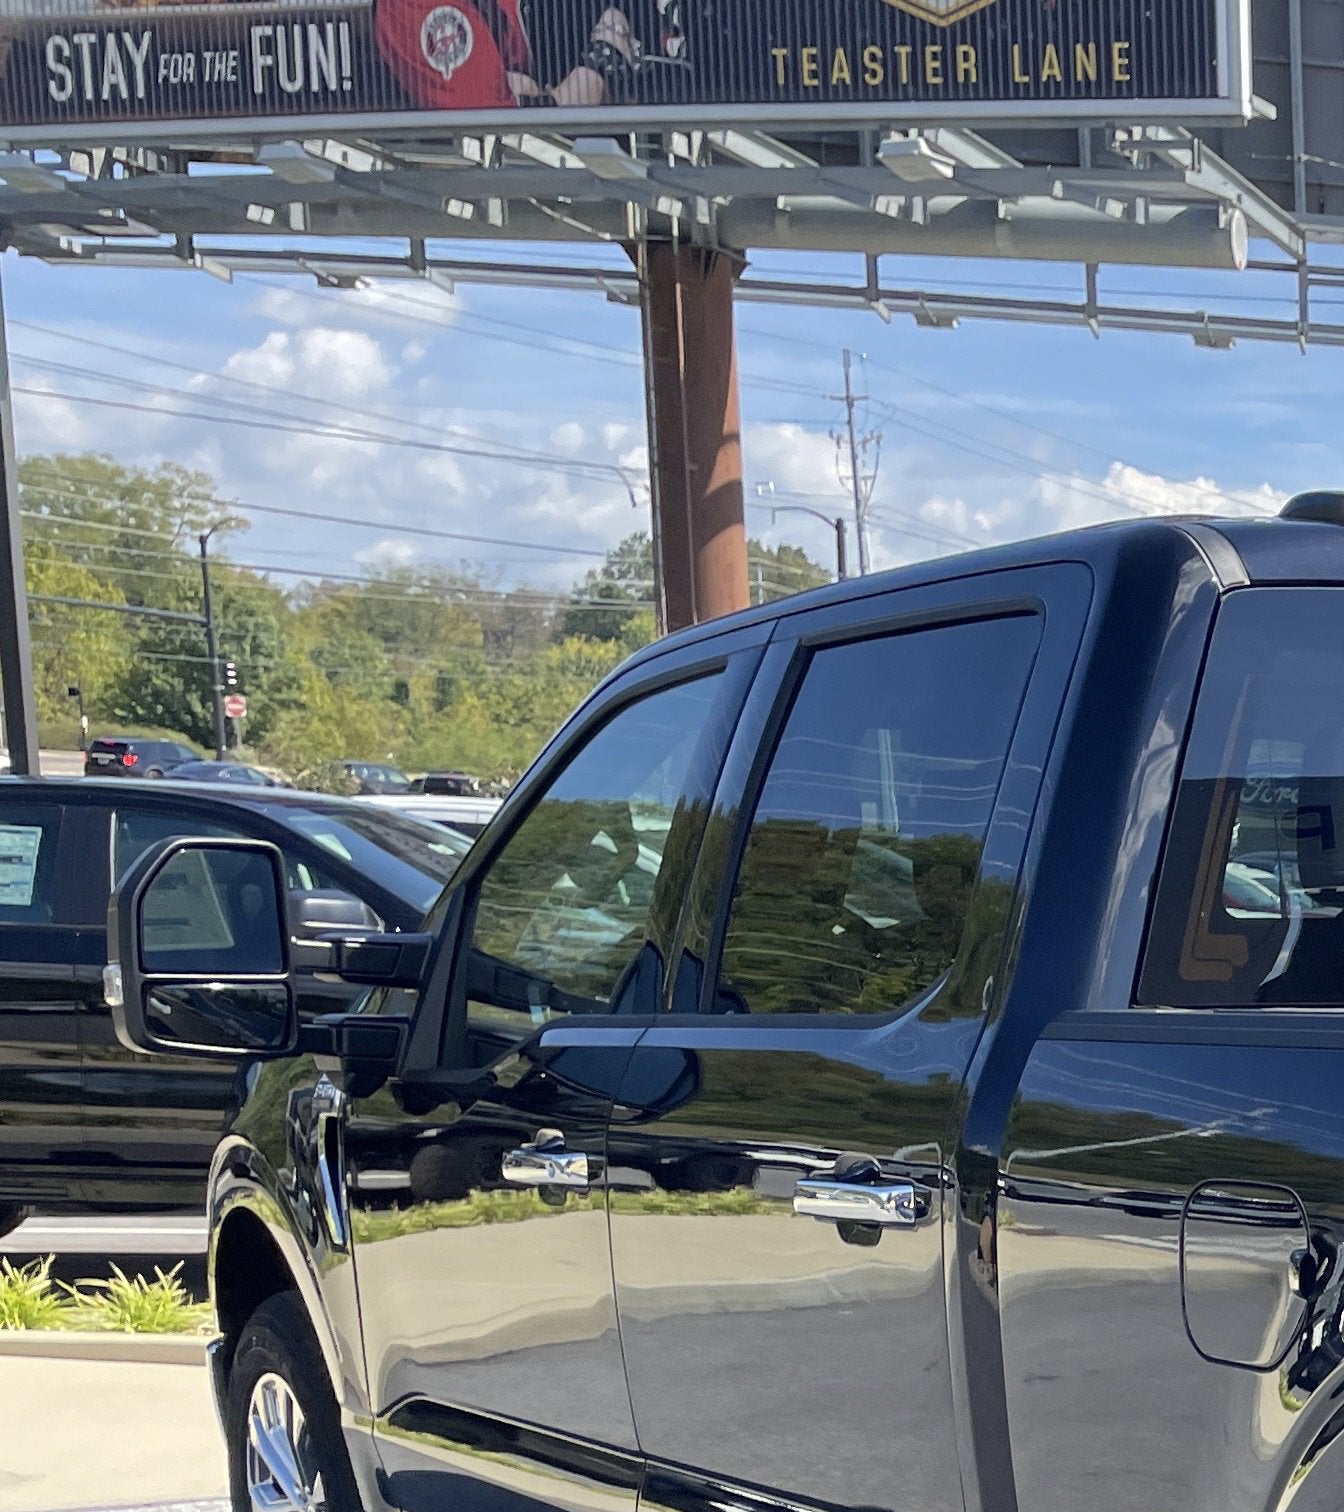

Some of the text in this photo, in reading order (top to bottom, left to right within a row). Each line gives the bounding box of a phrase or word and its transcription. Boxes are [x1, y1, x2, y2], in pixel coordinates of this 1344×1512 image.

[45, 21, 353, 101] STAY FOR THE FUN!
[771, 41, 1131, 87] TEASTER LANE
